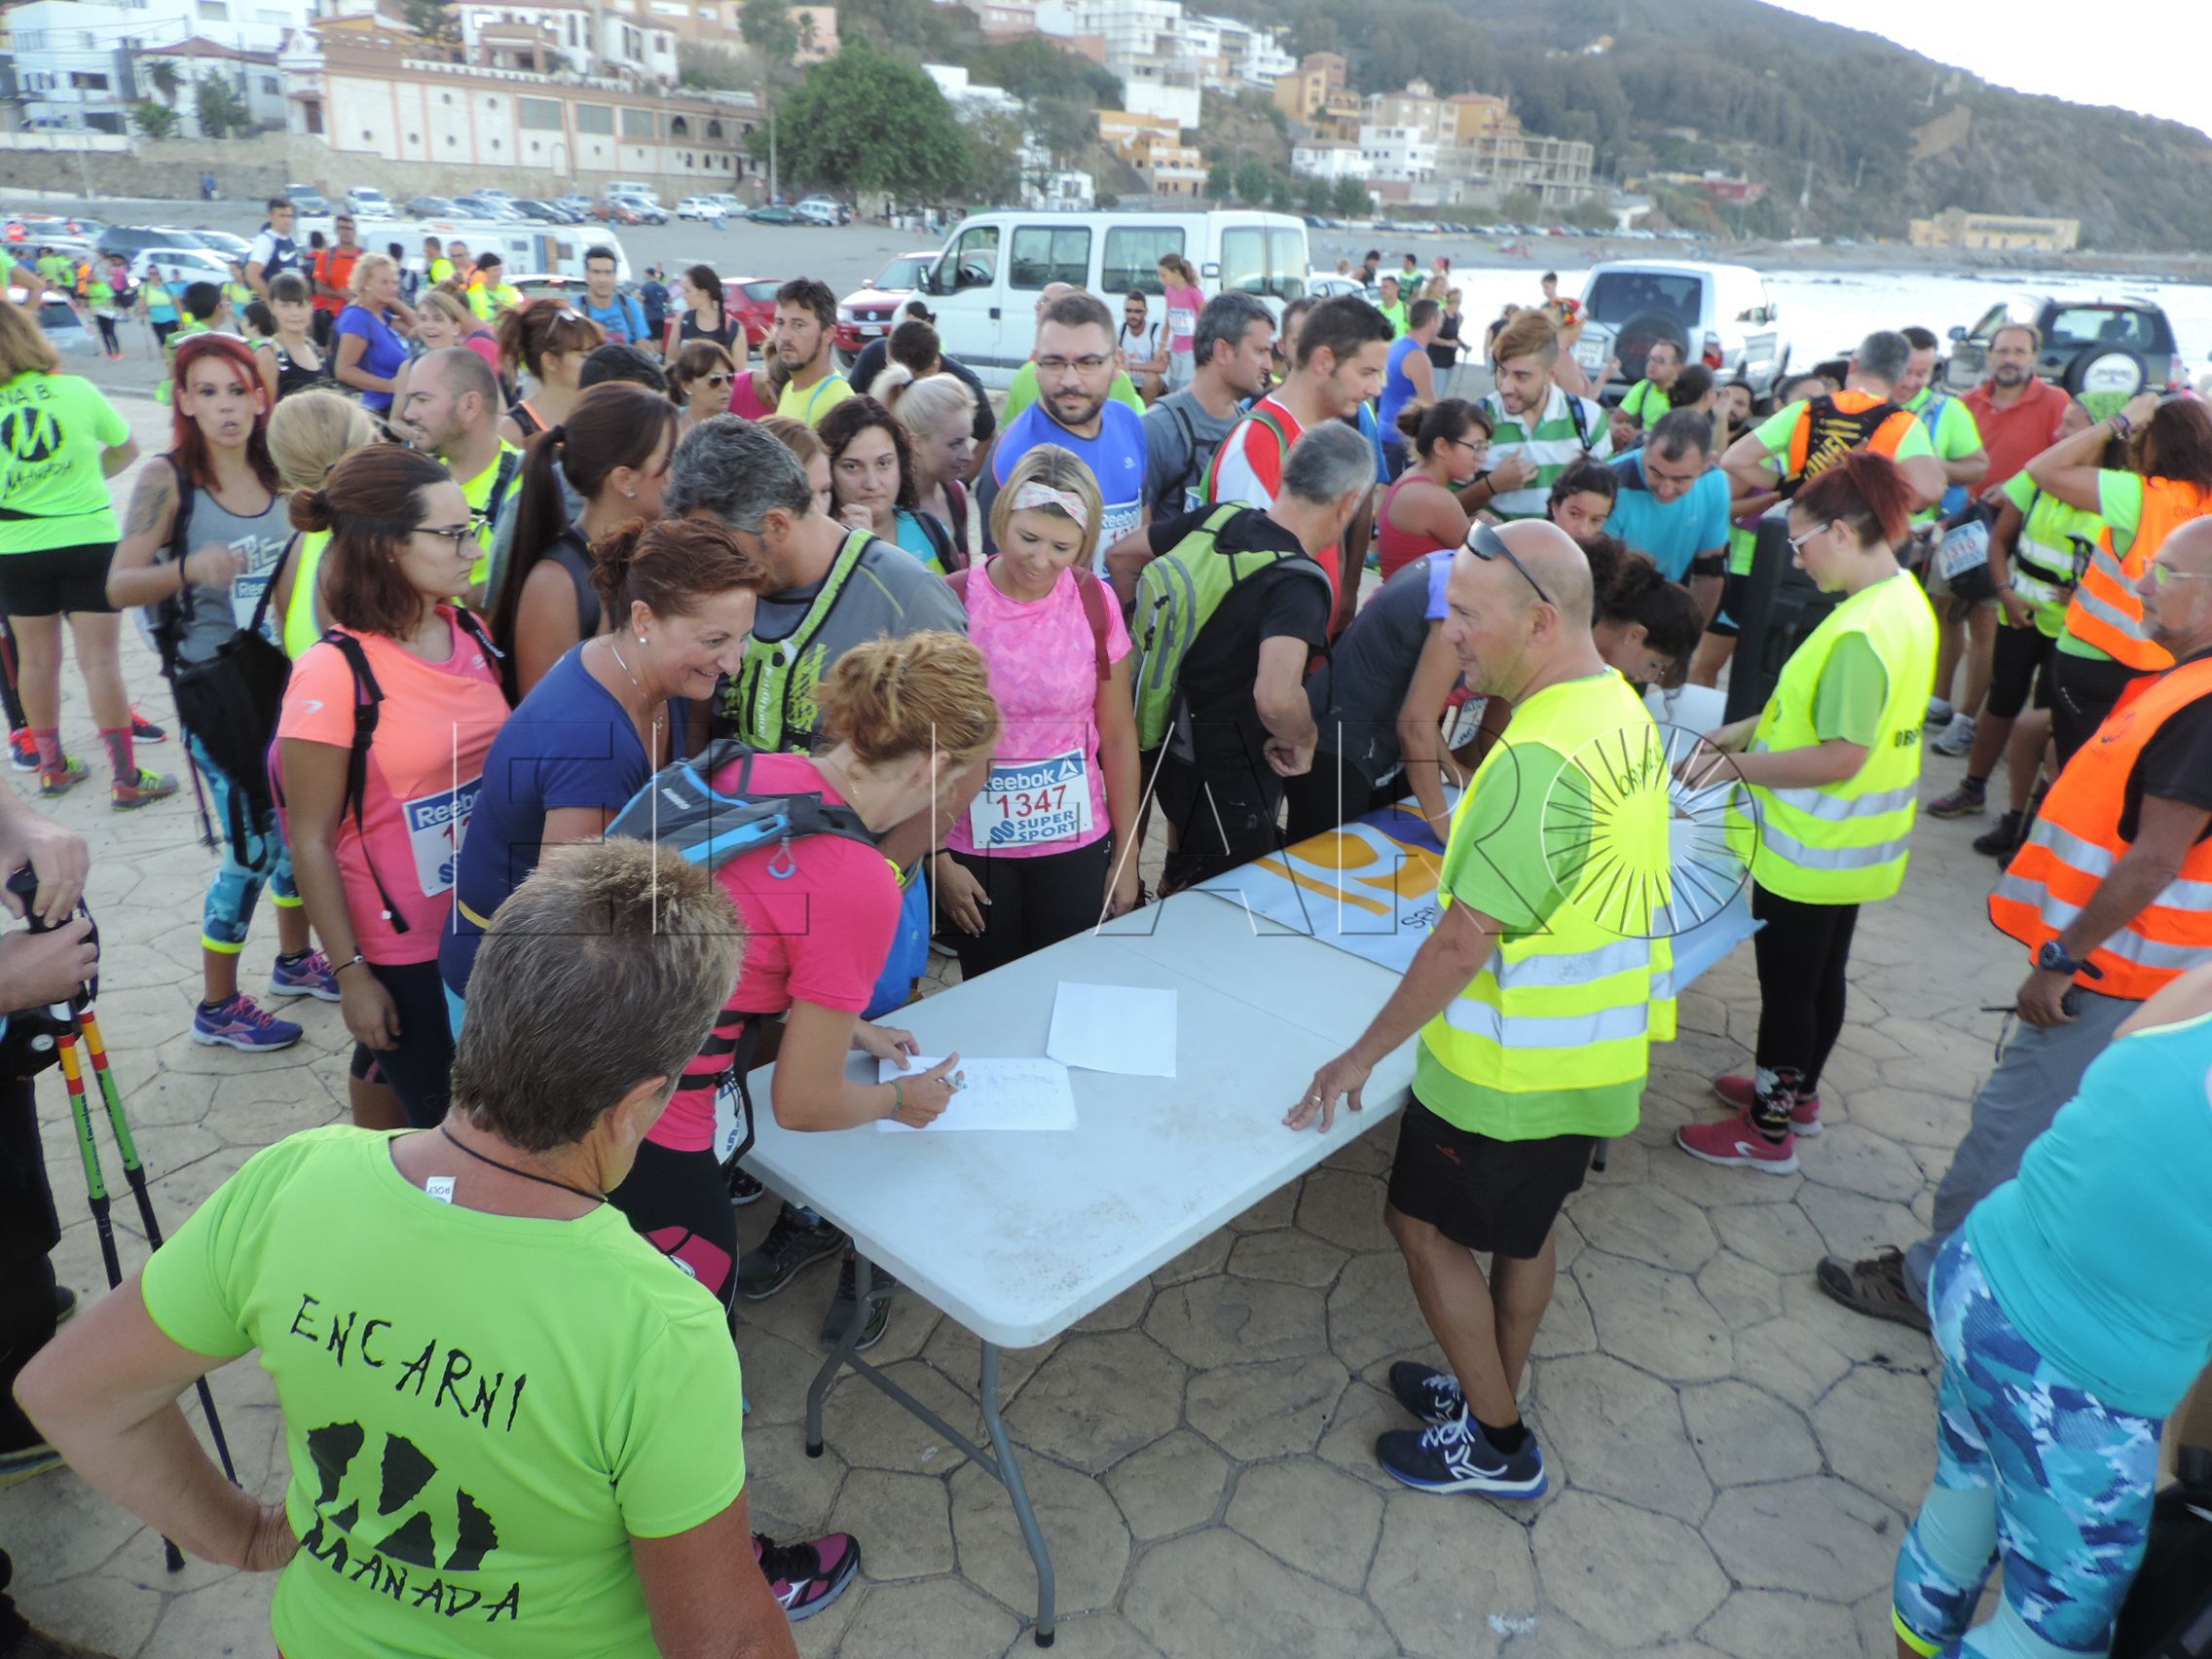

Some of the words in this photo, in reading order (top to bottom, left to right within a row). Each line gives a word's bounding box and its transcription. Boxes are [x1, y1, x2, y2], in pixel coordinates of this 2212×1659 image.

[996, 784, 1067, 819] 1347
[1016, 810, 1075, 830] SUPER
[1017, 821, 1079, 842] SPORT
[290, 1293, 527, 1433] ENCARNI
[300, 1507, 521, 1623] MANADA
